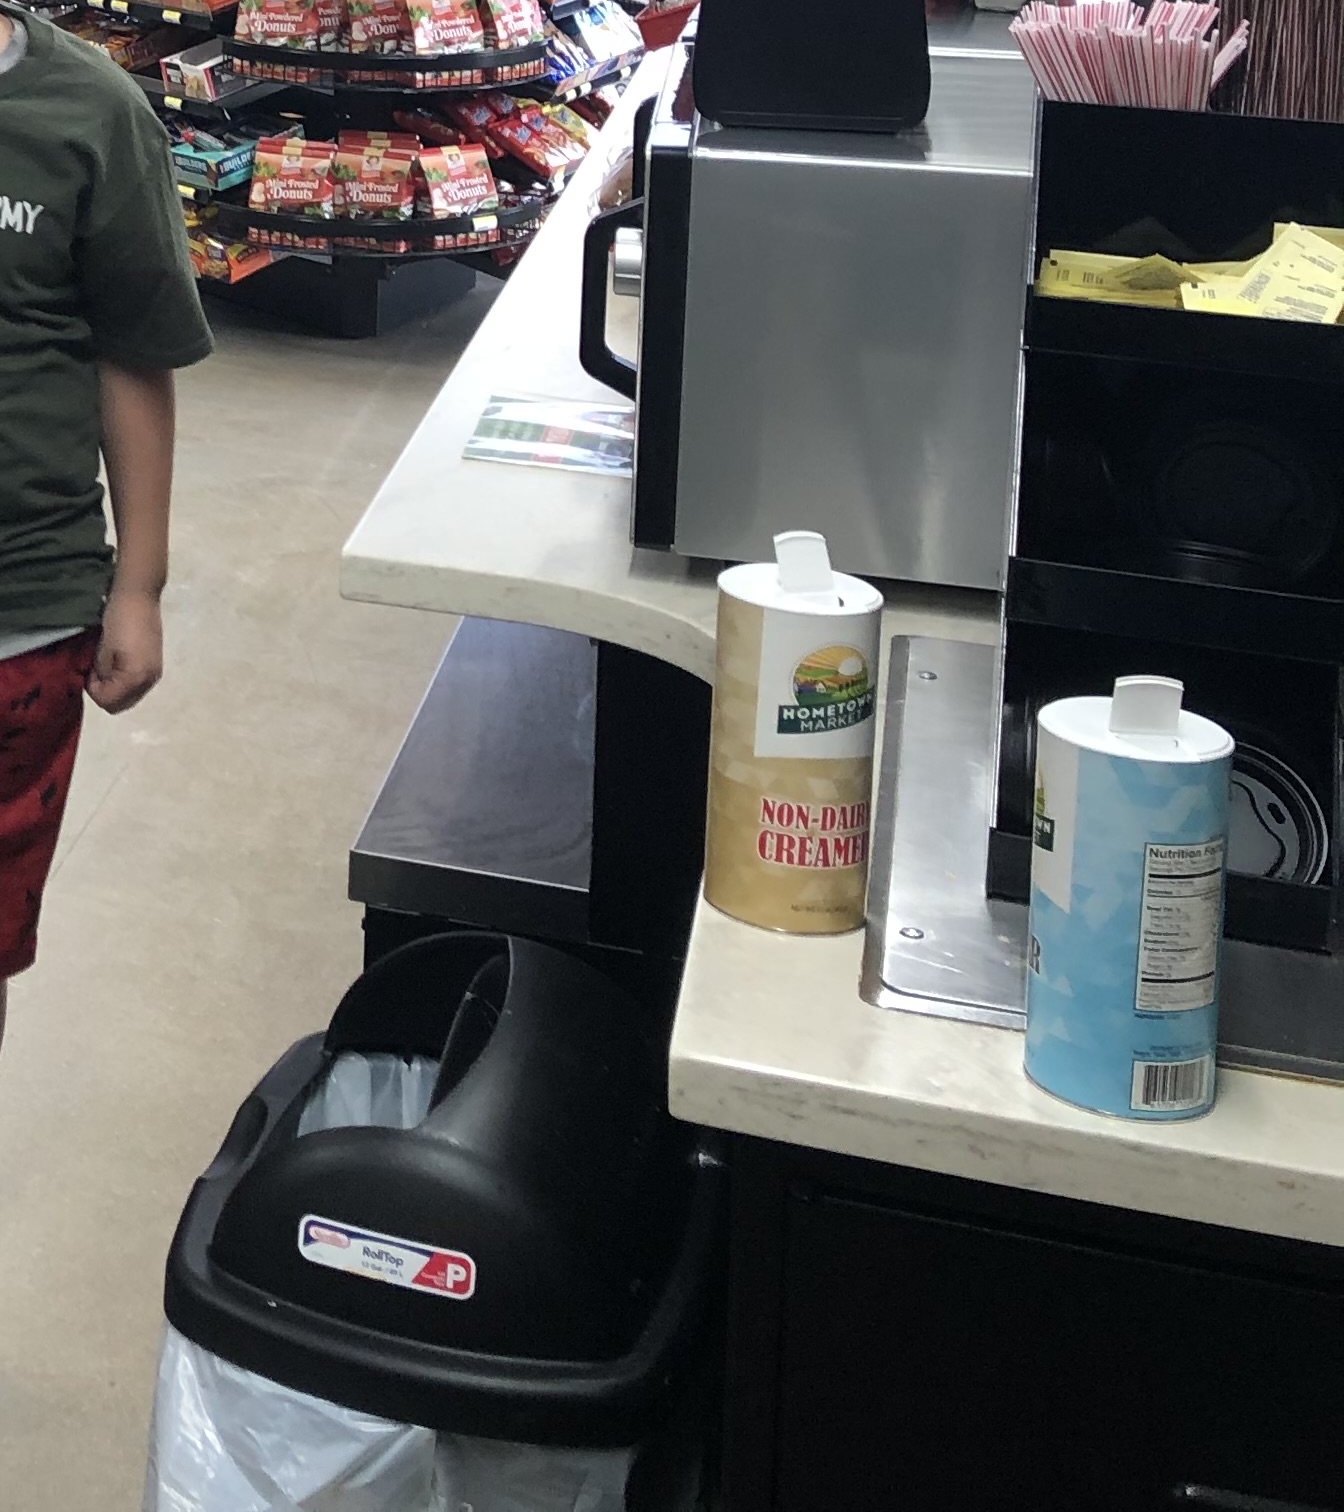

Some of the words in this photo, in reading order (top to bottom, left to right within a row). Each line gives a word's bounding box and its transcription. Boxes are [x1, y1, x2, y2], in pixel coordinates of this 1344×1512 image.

[259, 21, 296, 33] Donuts
[370, 23, 399, 36] Don
[433, 25, 472, 39] Donuts
[271, 187, 312, 200] Donuts
[351, 190, 392, 203] Donuts
[448, 186, 487, 203] Donuts
[783, 693, 872, 720] HOMETOWN
[800, 710, 863, 732] MARKET
[762, 798, 869, 831] NON-DAIR
[1149, 848, 1201, 859] Nutrition
[362, 1246, 404, 1267] RollTop
[446, 1263, 467, 1288] P
